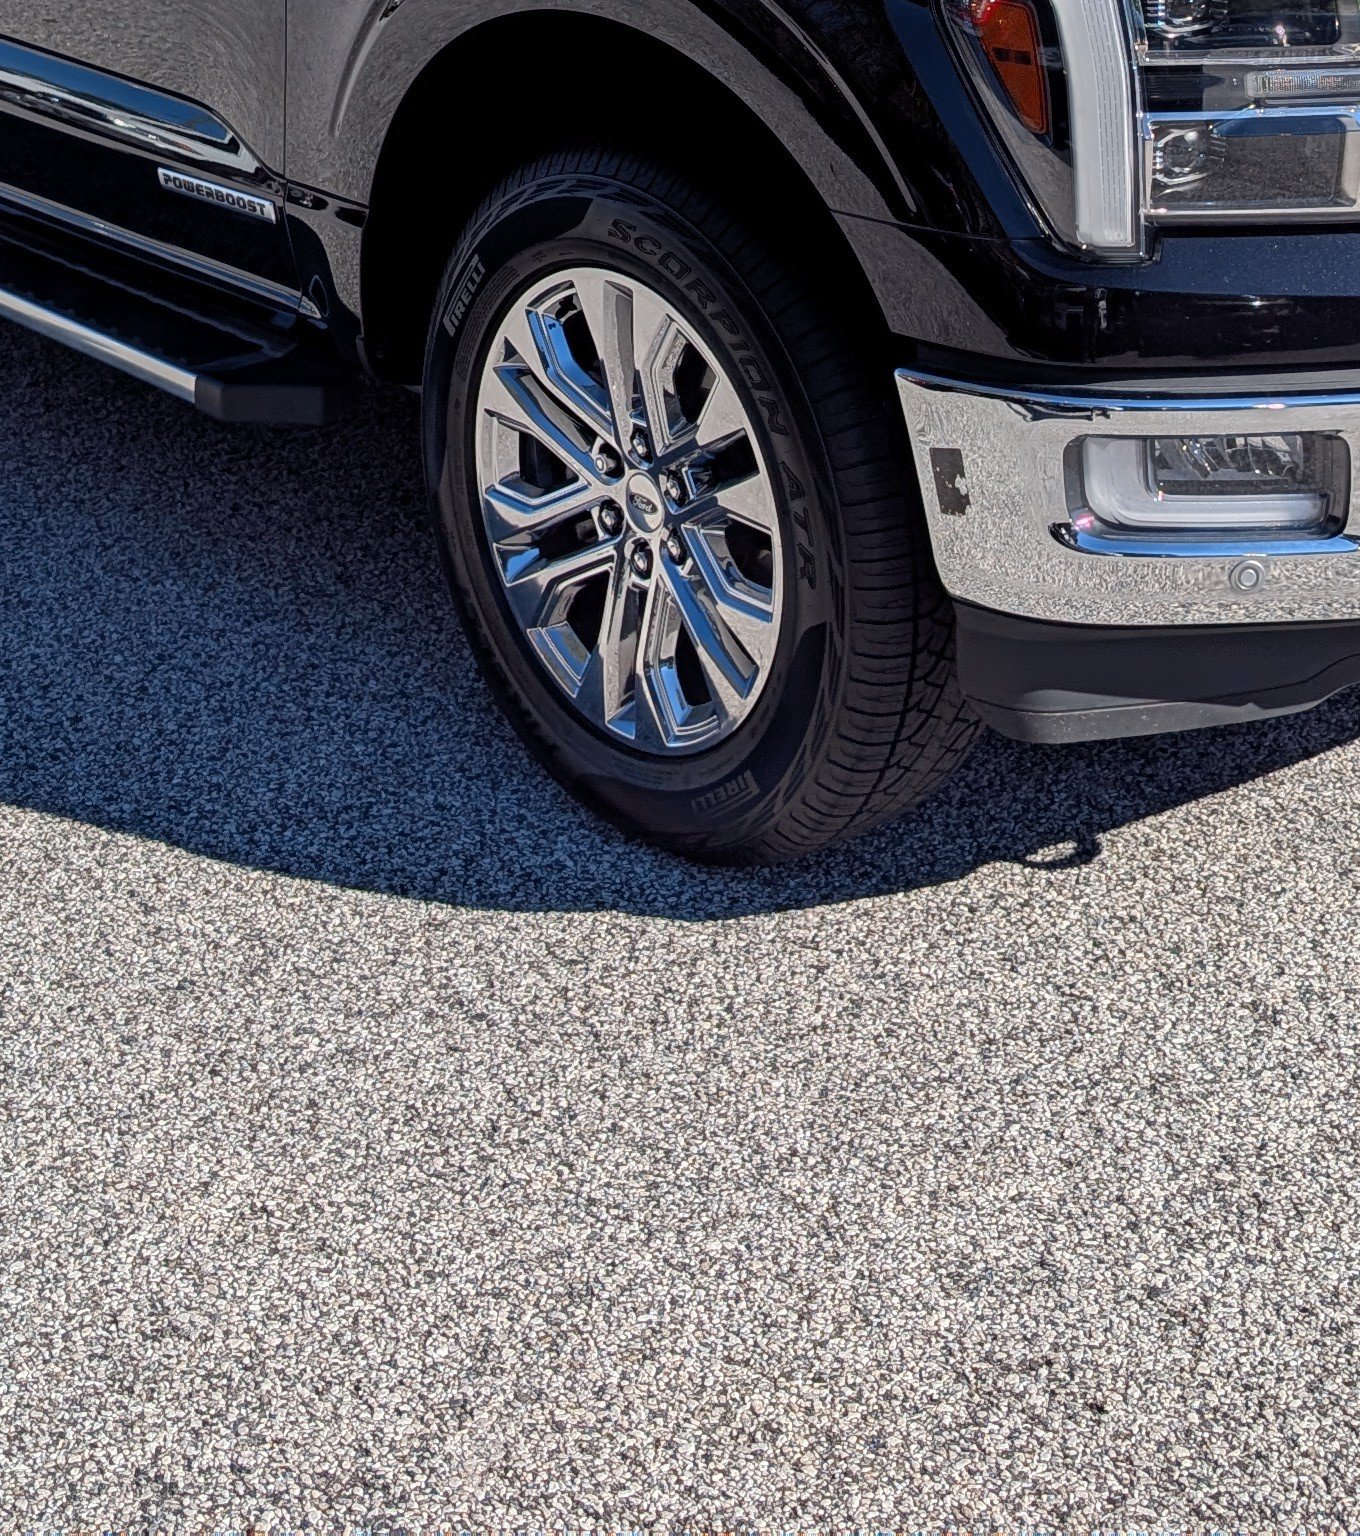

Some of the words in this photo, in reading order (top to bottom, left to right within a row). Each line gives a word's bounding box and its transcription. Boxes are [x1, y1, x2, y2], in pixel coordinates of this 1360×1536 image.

[163, 172, 266, 216] POWERBOOST
[443, 253, 486, 337] PIRELLI
[607, 217, 789, 437] SCORPION
